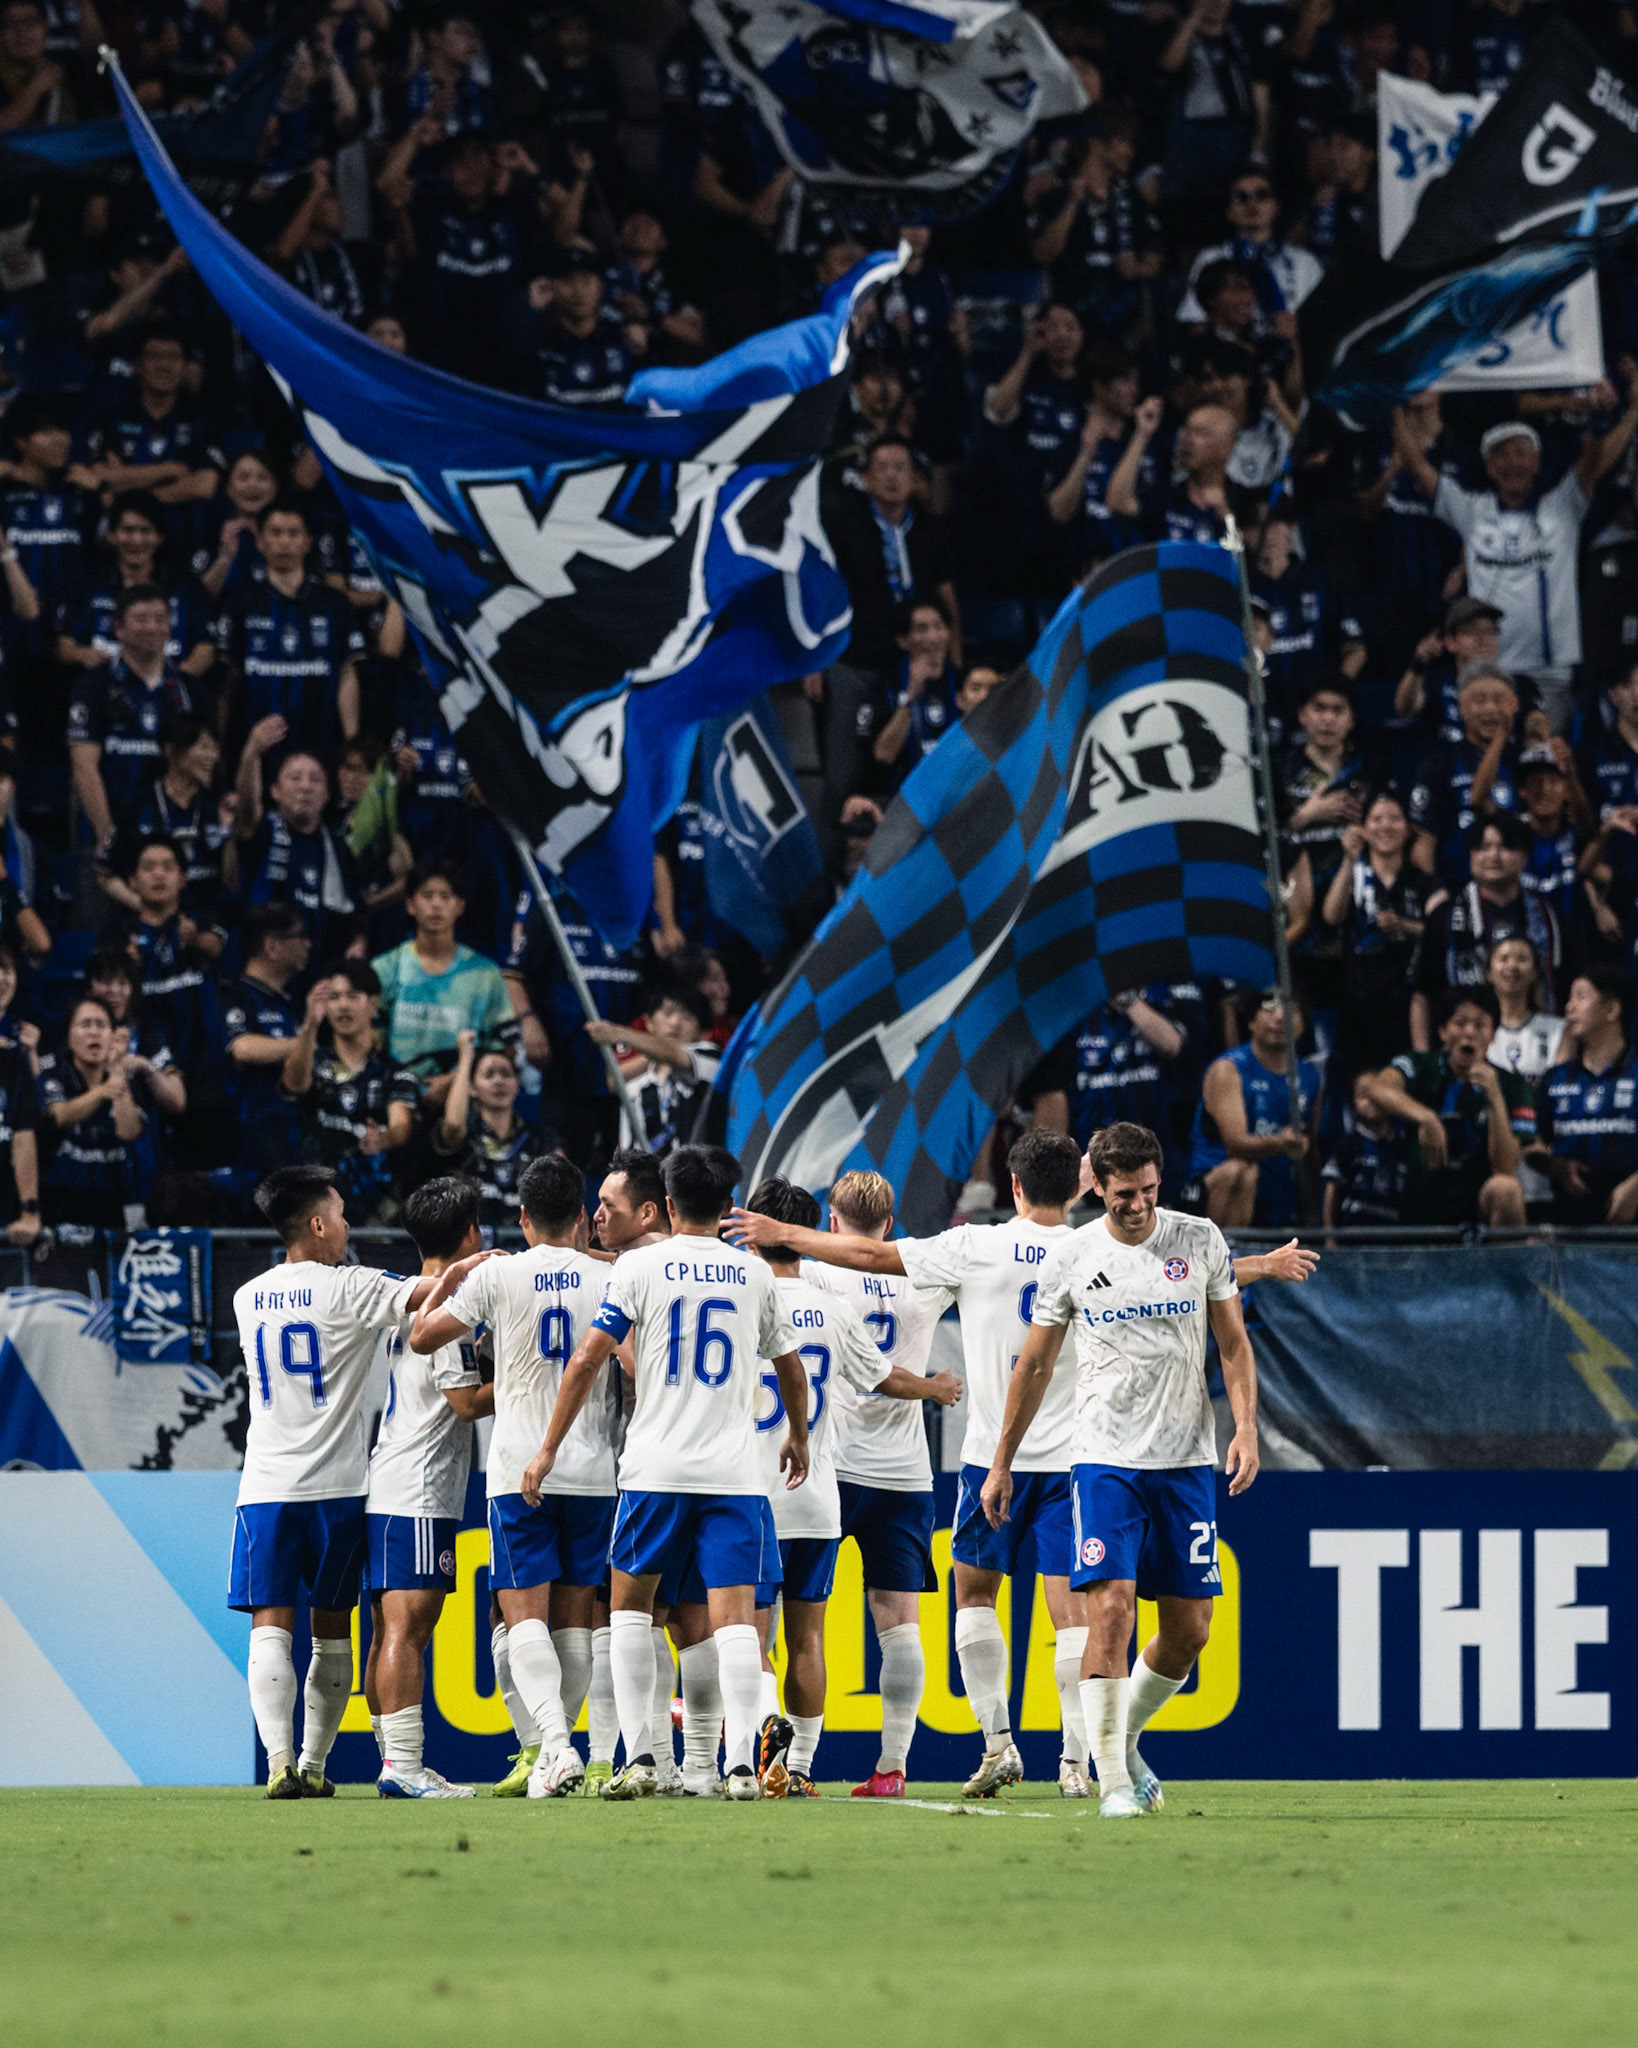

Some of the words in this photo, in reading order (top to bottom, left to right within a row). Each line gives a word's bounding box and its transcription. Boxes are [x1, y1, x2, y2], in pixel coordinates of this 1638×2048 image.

[244, 657, 332, 676] Panasonic
[1014, 1243, 1047, 1265] LOP
[534, 1271, 580, 1292] OKUBO
[863, 1276, 896, 1298] HALL
[792, 1309, 825, 1328] GAO
[538, 1305, 573, 1374] 9
[664, 1295, 738, 1389] 16
[253, 1320, 328, 1411] 19
[1310, 1529, 1609, 1729] THE
